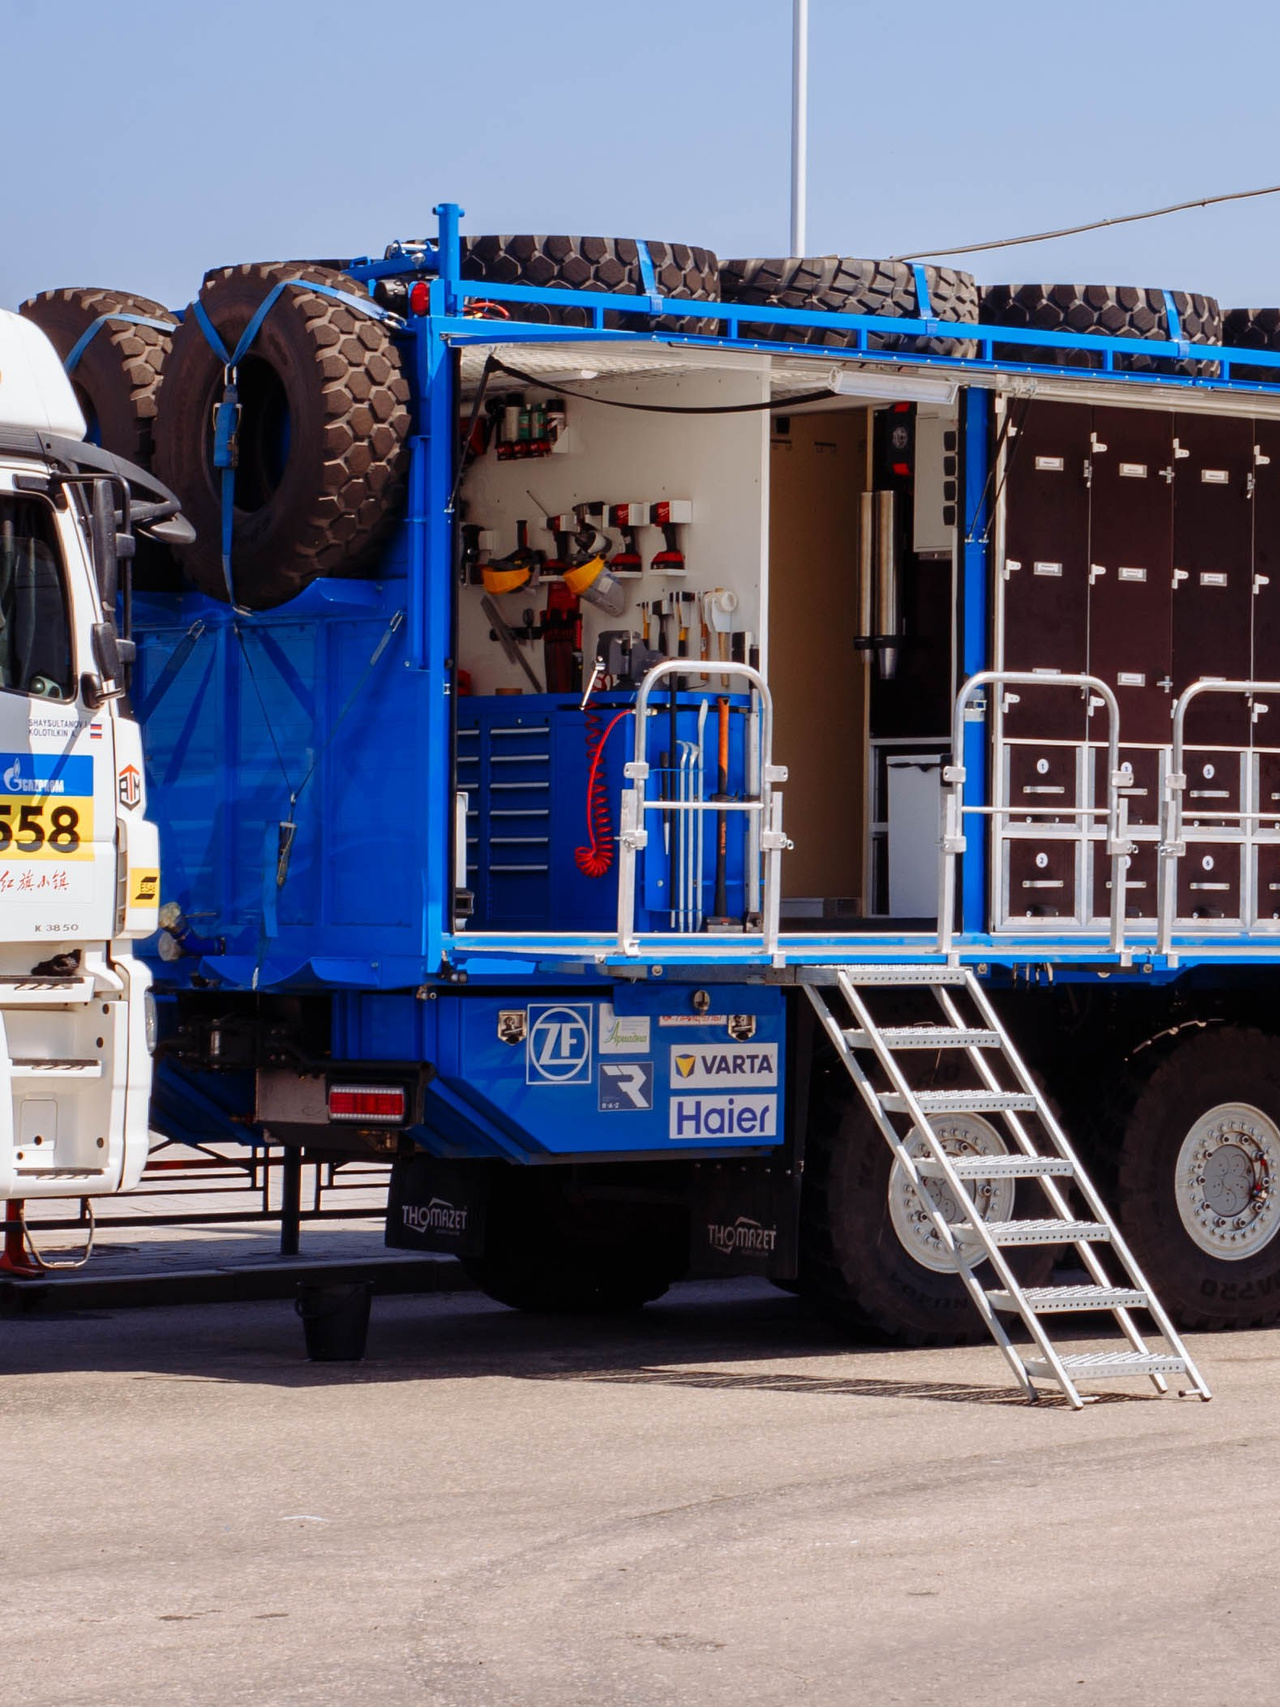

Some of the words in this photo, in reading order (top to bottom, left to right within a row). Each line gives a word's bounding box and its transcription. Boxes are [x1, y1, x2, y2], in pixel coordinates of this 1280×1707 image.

[35, 924, 42, 932] K
[536, 1023, 584, 1065] ZF
[701, 1054, 773, 1075] VARTA
[677, 1098, 769, 1135] Haier
[402, 1205, 467, 1230] THOMAZET
[707, 1224, 777, 1250] THOMAZET
